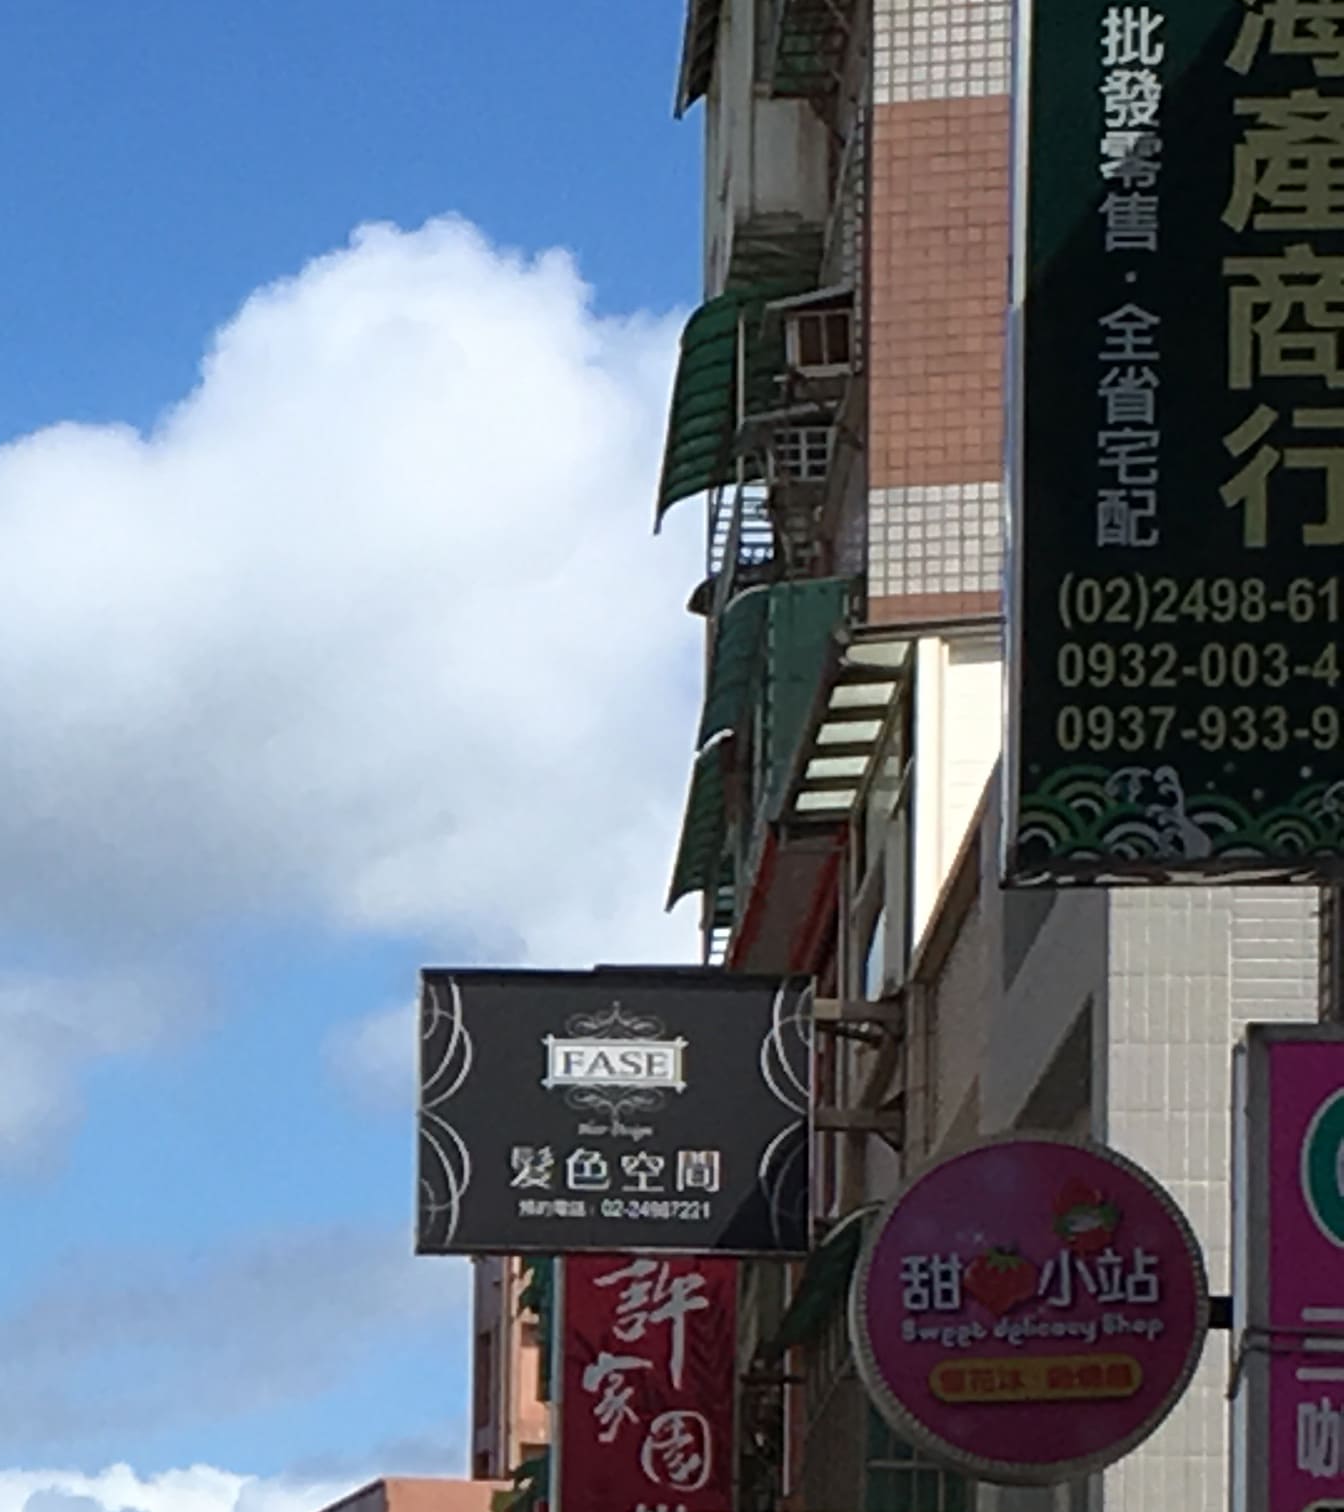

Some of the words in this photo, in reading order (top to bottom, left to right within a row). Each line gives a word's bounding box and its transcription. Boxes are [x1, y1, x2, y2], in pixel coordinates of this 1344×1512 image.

[1059, 572, 1338, 631] (02)2498-61
[1057, 643, 1340, 688] 0932-003-4
[1057, 706, 1339, 751] 0937-933-9
[562, 1050, 670, 1077] FASE
[510, 1145, 721, 1193] 髮色空間
